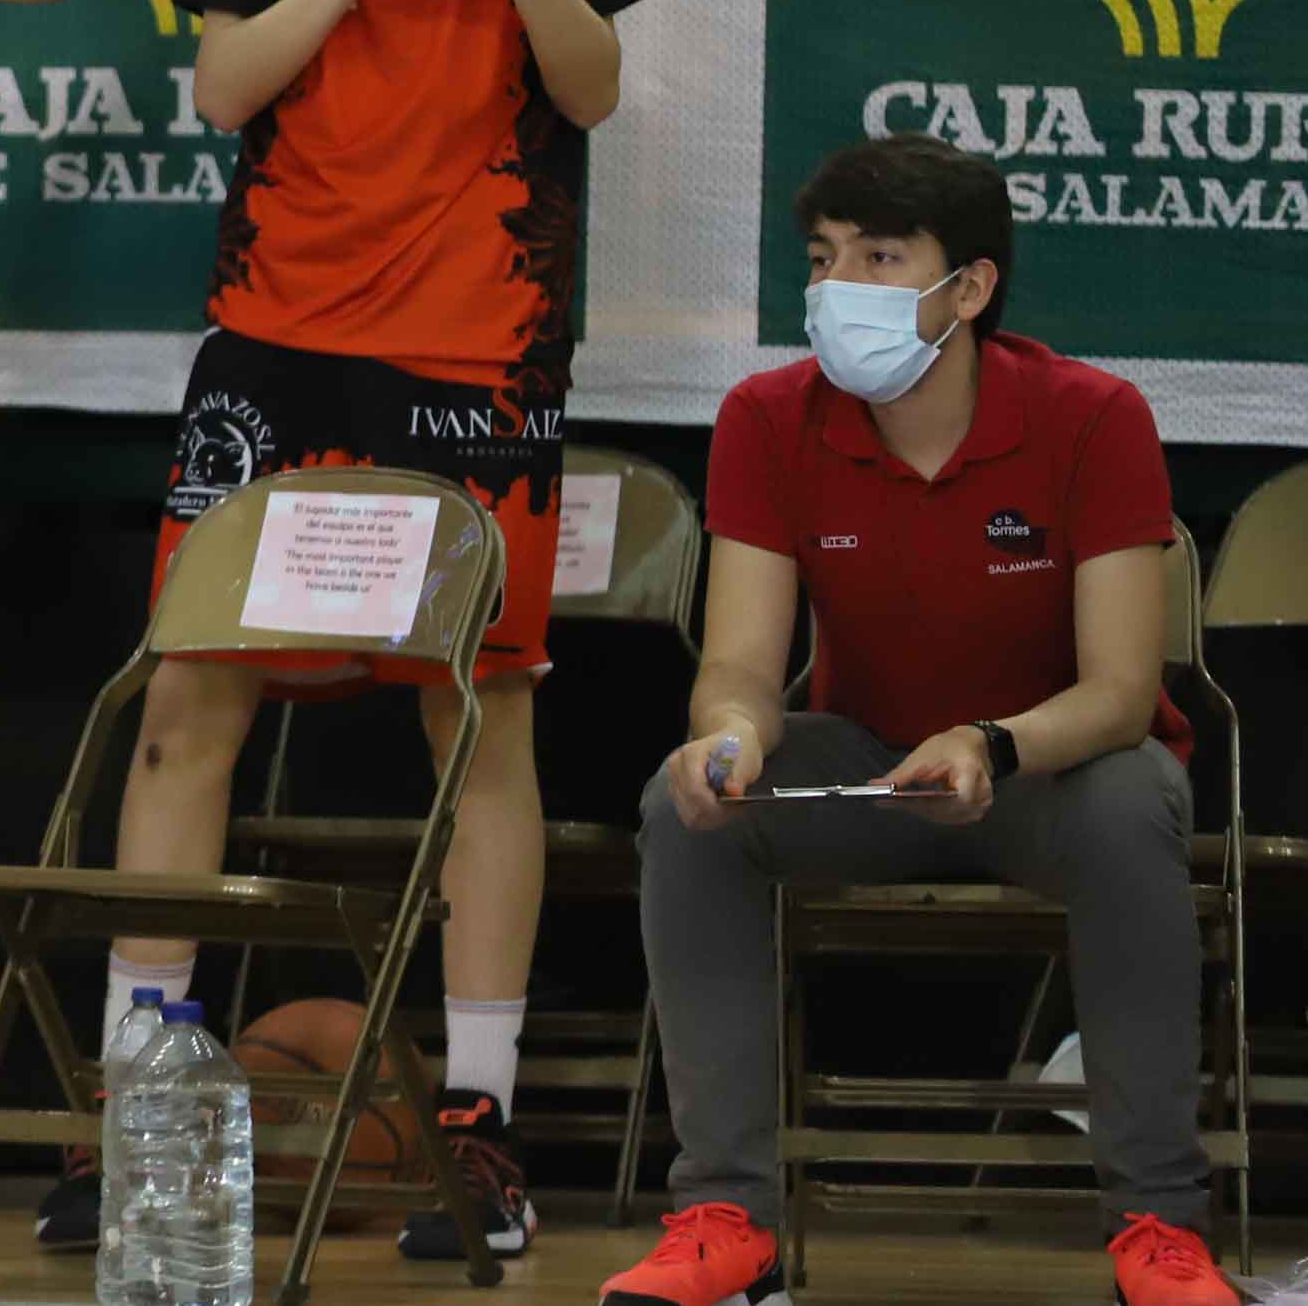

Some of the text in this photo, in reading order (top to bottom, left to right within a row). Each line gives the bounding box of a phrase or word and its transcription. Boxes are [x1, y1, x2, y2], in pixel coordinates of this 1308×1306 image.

[863, 80, 1106, 160] CAJA
[43, 151, 238, 203] SALA
[1006, 172, 1308, 229] SALAMA
[985, 525, 1031, 537] Tormes
[988, 559, 1056, 575] SALAMANCA
